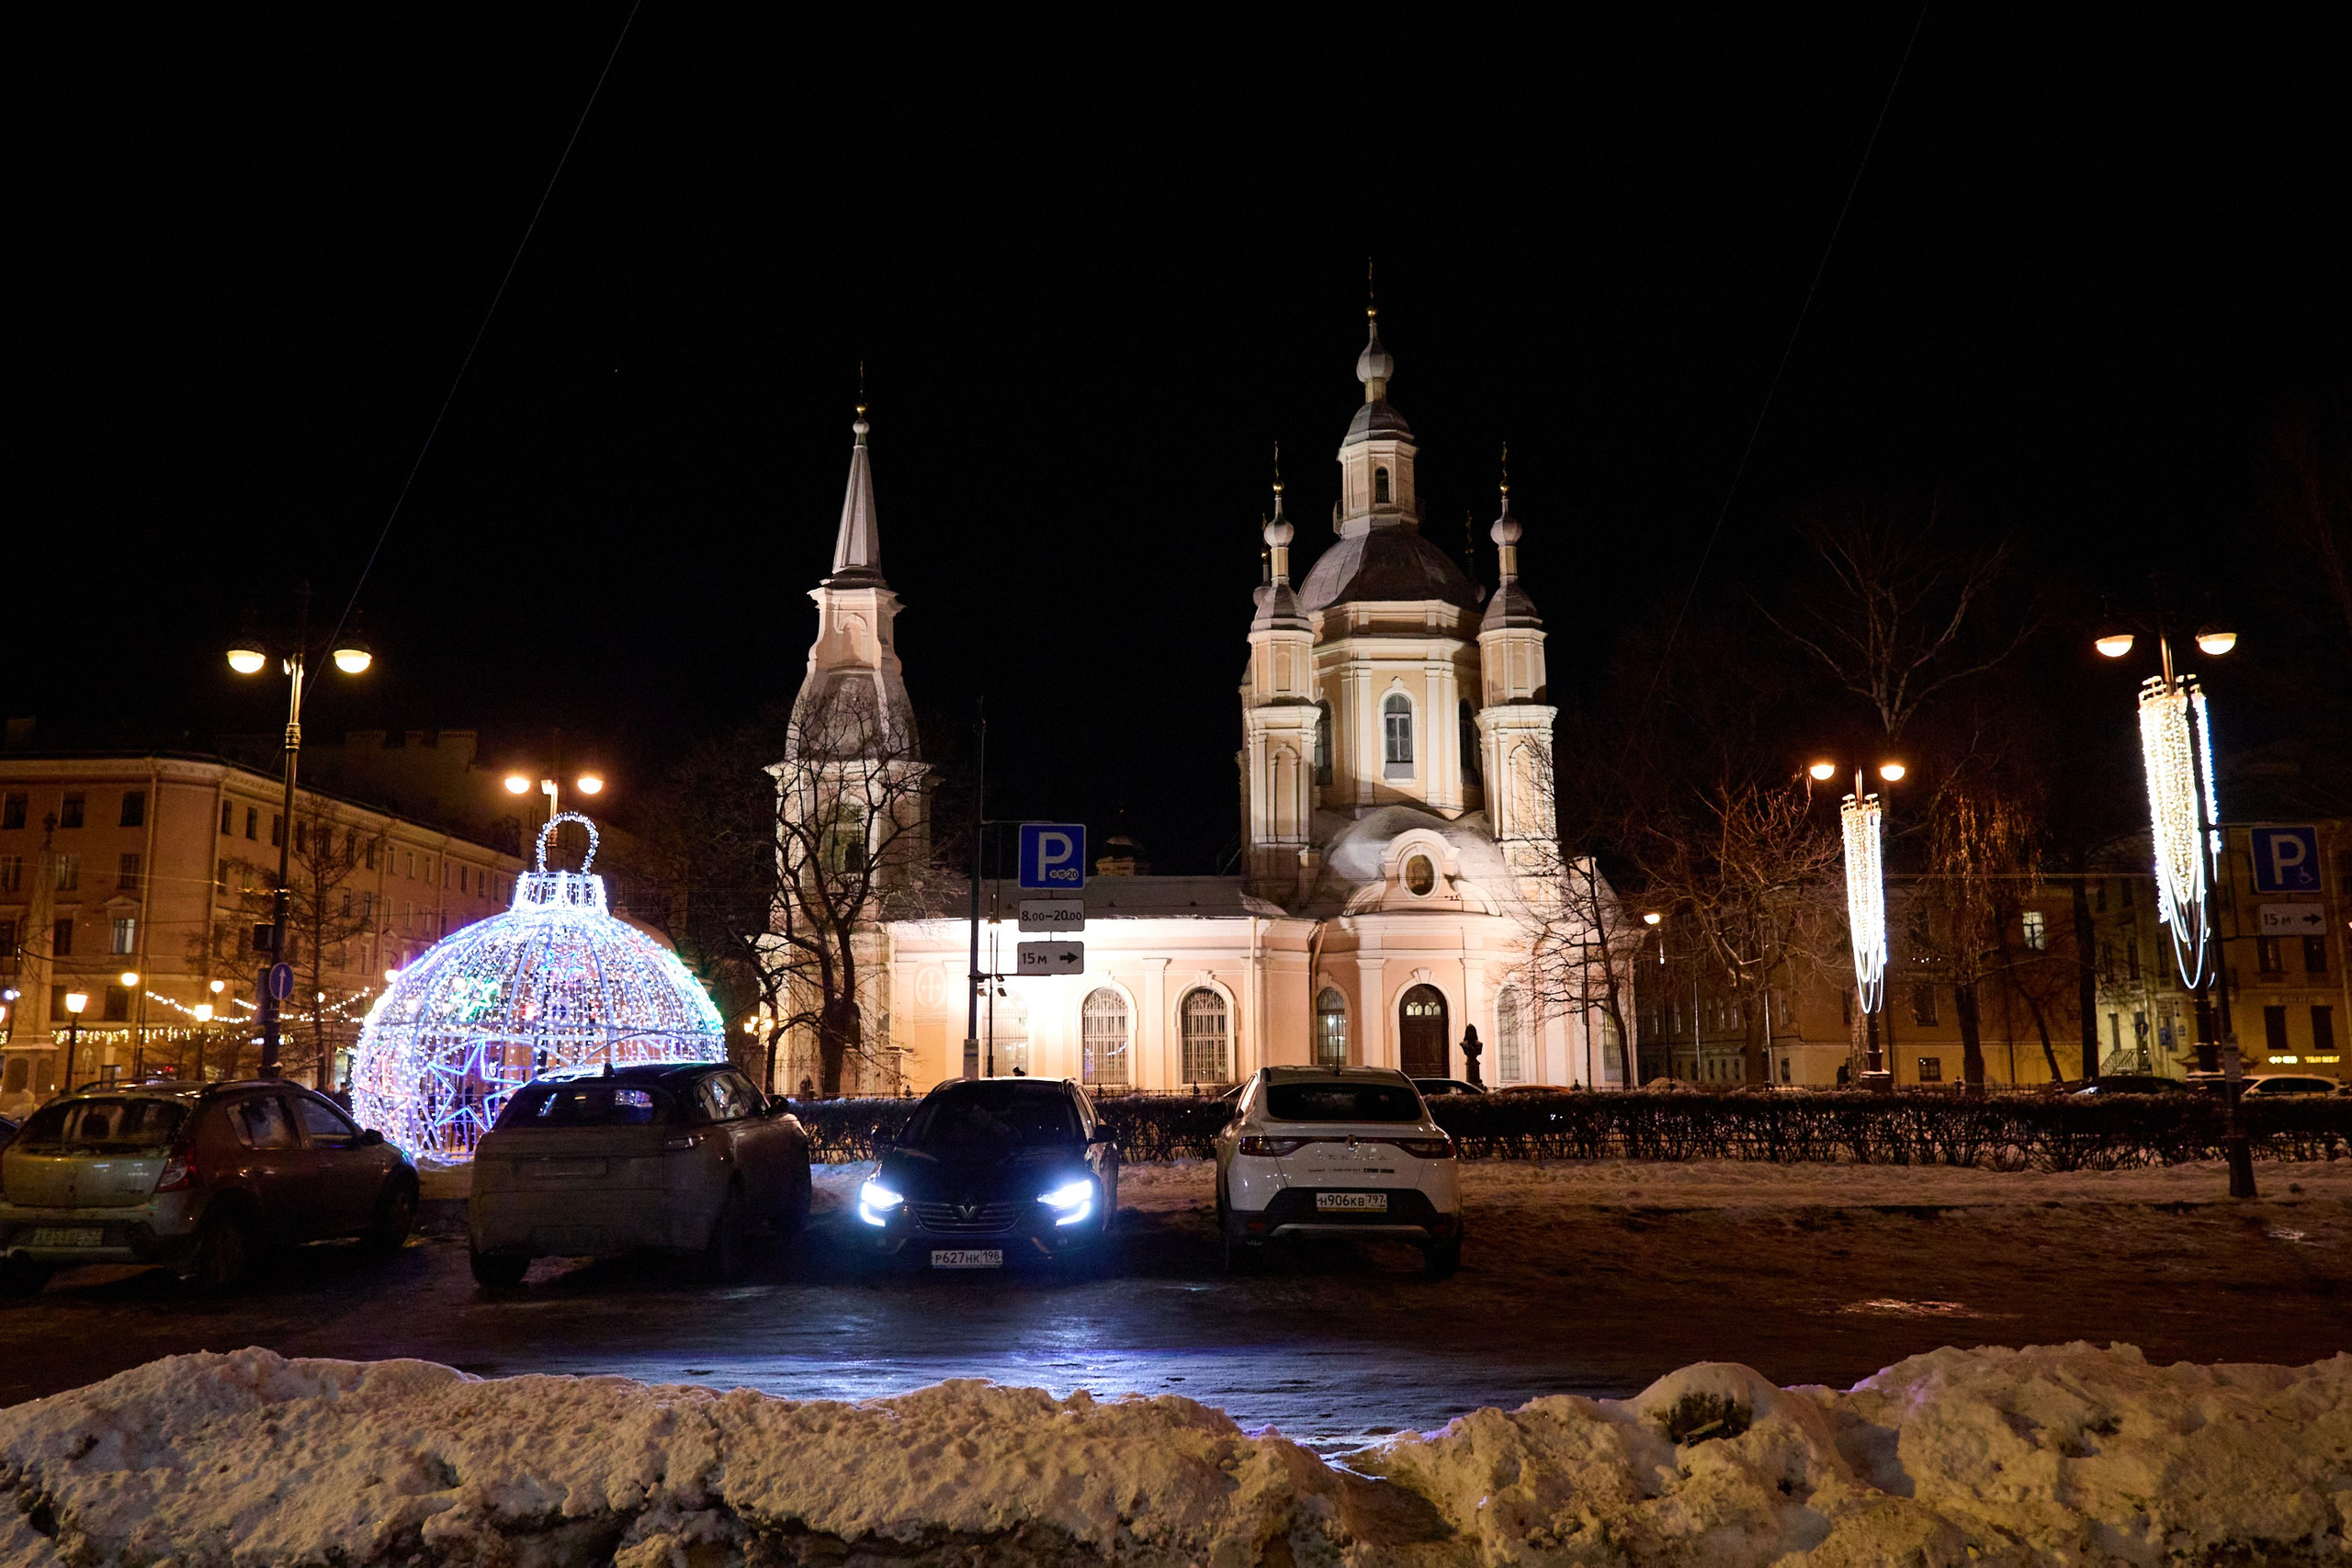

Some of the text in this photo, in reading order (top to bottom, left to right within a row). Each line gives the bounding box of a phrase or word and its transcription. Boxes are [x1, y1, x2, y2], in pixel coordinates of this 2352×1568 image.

[1037, 831, 1073, 882] P
[2269, 834, 2306, 885] P
[1067, 870, 1078, 879] 20
[2263, 913, 2278, 926] 15
[1022, 953, 1035, 964] 15
[1366, 1194, 1384, 1204] 797
[982, 1251, 1000, 1260] 198
